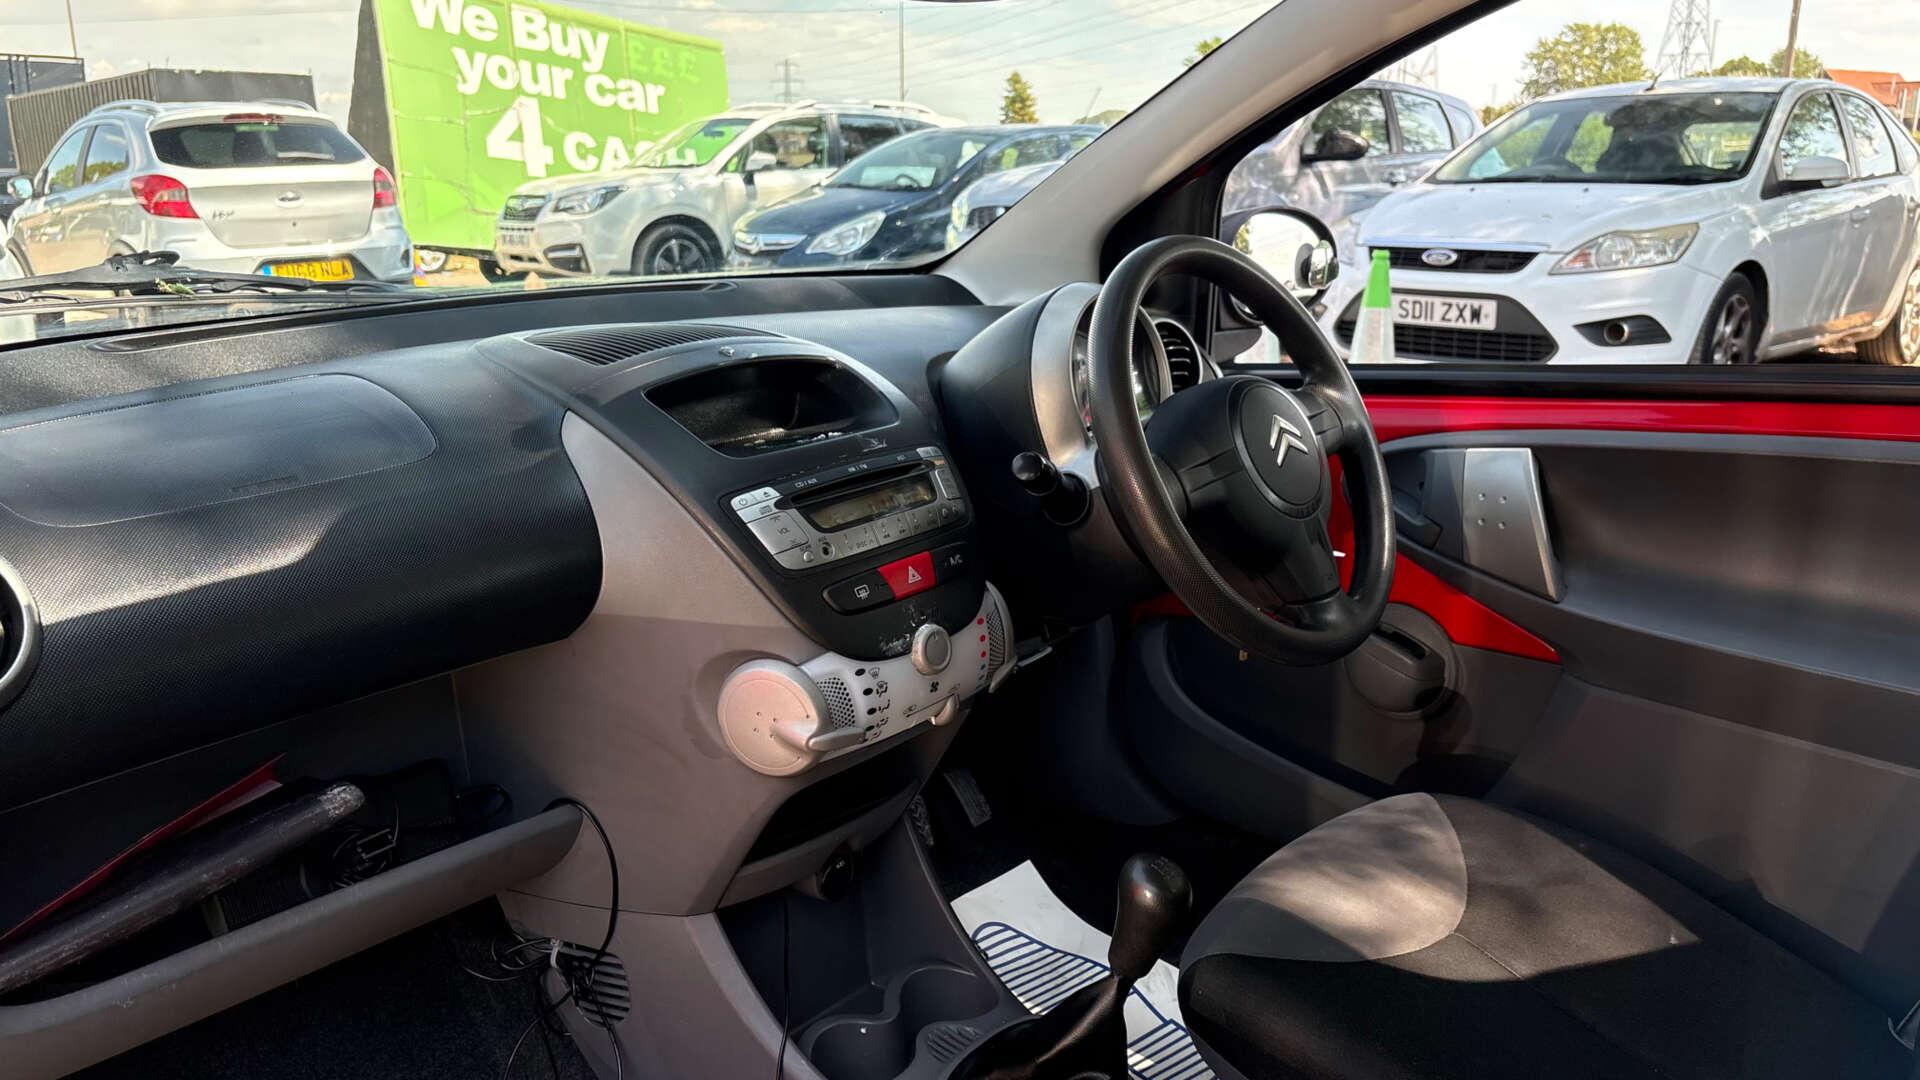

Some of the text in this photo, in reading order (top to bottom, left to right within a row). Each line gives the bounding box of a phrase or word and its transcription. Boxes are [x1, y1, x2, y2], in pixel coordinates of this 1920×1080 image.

[411, 0, 609, 73] We Buy
[451, 47, 666, 115] your car
[486, 96, 553, 177] 4
[1398, 297, 1482, 325] SD11 ZXW
